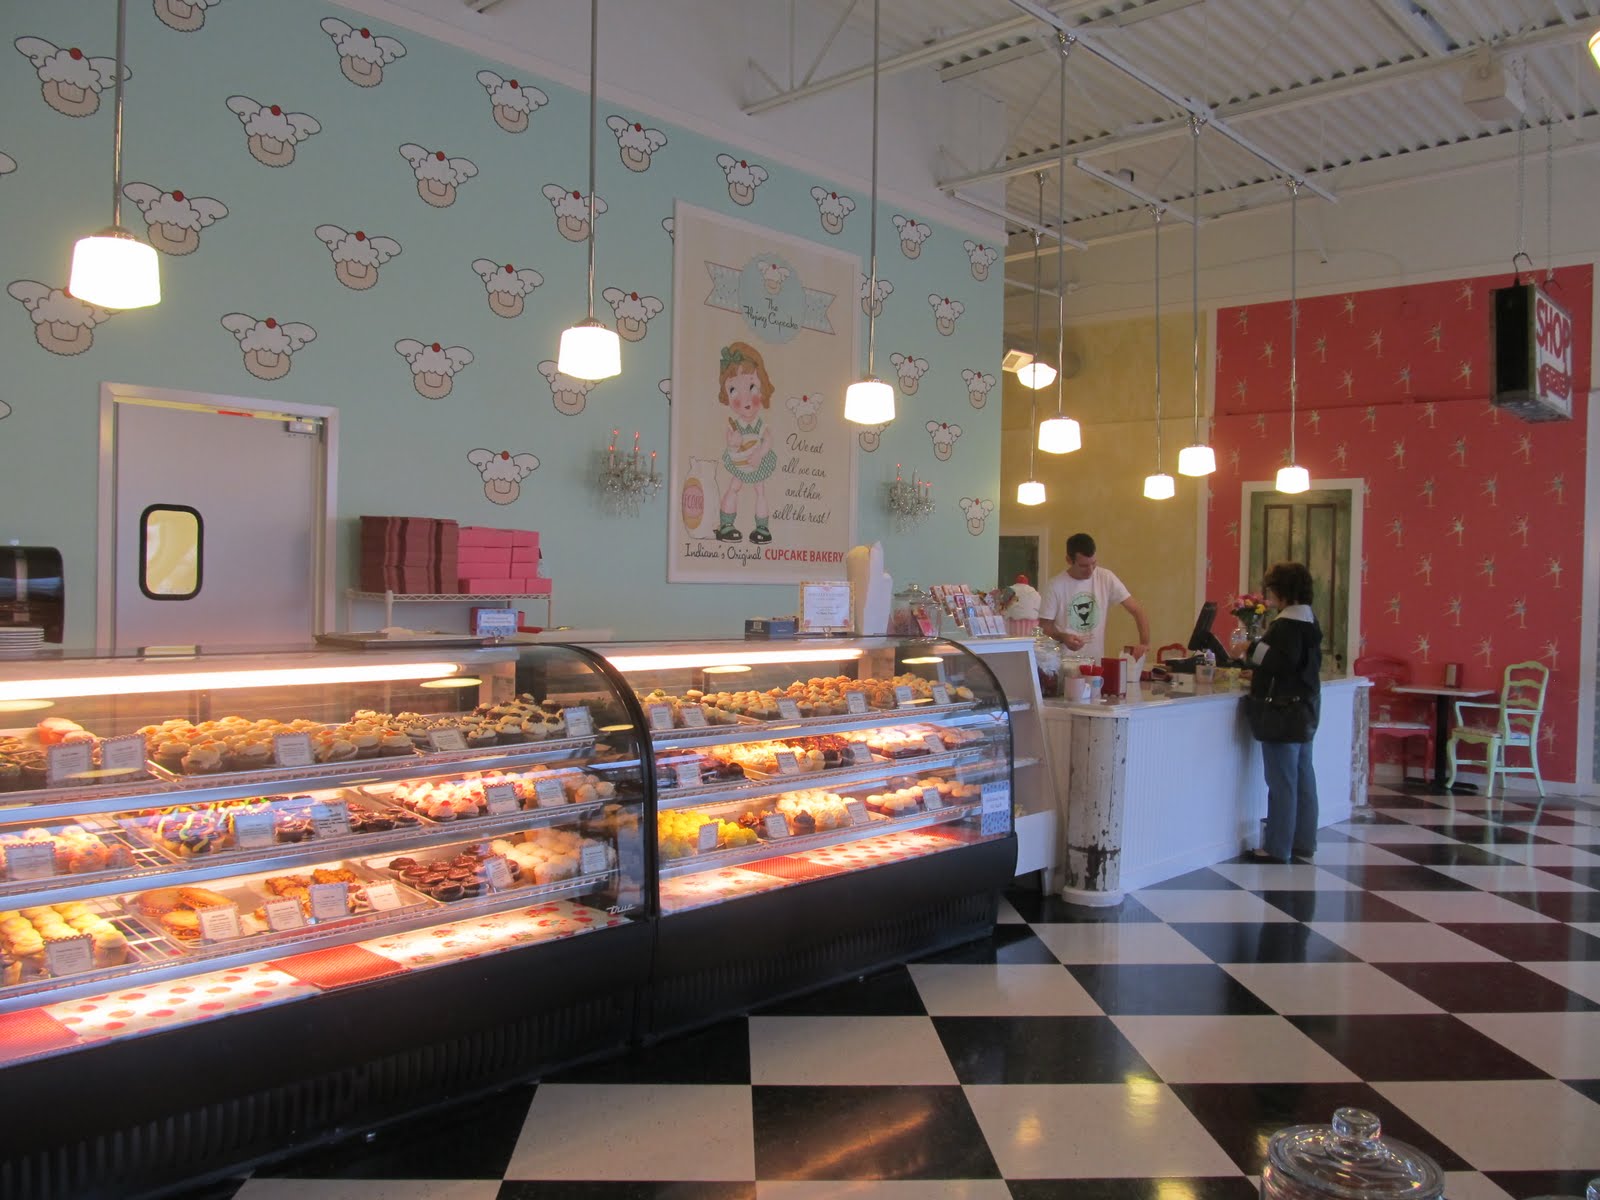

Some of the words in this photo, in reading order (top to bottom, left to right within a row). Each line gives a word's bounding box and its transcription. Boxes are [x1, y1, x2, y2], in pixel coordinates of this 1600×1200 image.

[765, 297, 778, 311] The
[743, 305, 767, 328] Flying
[768, 311, 799, 333] Cupcake
[1536, 298, 1570, 363] SHOP
[786, 433, 808, 452] We
[810, 442, 824, 454] eat
[781, 457, 799, 473] all
[799, 467, 810, 475] we
[811, 469, 826, 477] can
[785, 481, 804, 498] and
[803, 482, 822, 500] then
[772, 503, 793, 520] sell
[792, 504, 806, 522] the
[809, 511, 831, 524] rest!
[684, 543, 726, 560] Indiana's
[727, 546, 761, 567] Original
[764, 549, 808, 562] CUPCAKE
[809, 551, 844, 563] BAKERY
